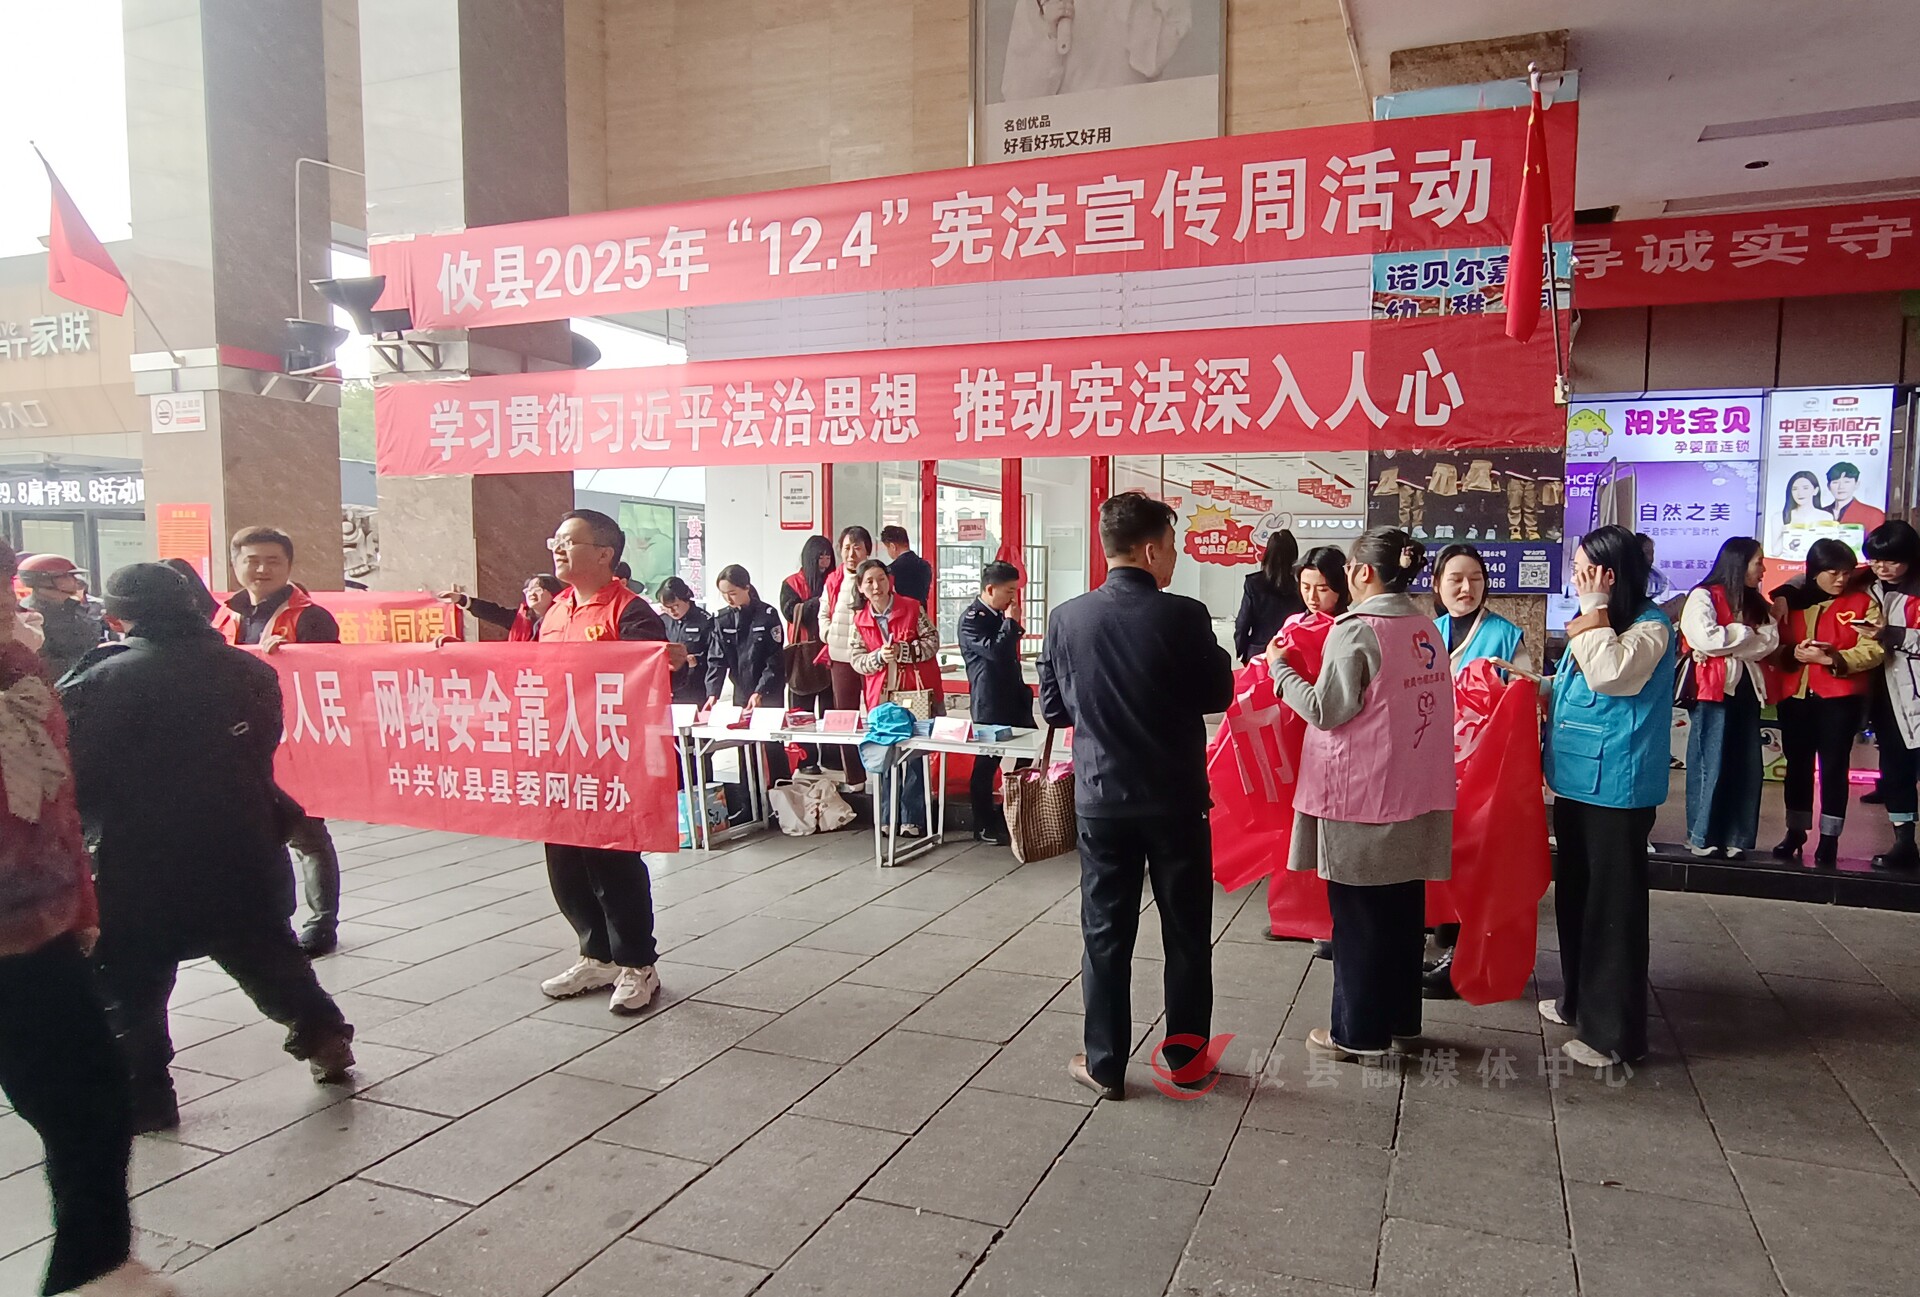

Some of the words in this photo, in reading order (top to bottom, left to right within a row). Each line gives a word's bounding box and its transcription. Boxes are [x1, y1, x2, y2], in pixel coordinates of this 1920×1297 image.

[1004, 114, 1051, 132] 名创优品
[1003, 126, 1112, 155] 好看好玩又好用
[30, 311, 91, 356] 家联
[430, 373, 919, 462] 学习贯彻习近平法治思想
[953, 347, 1464, 443] 推动宪法深入人心
[1625, 406, 1751, 436] 阳光宝贝
[1779, 417, 1881, 433] 中国专利配方
[1674, 439, 1750, 454] 孕婴童连锁
[1778, 433, 1880, 449] 宝宝超凡守护
[1640, 503, 1731, 522] 自然之美
[371, 668, 630, 761] 网络安全靠人民
[389, 761, 632, 814] 中共攸县县委网信办
